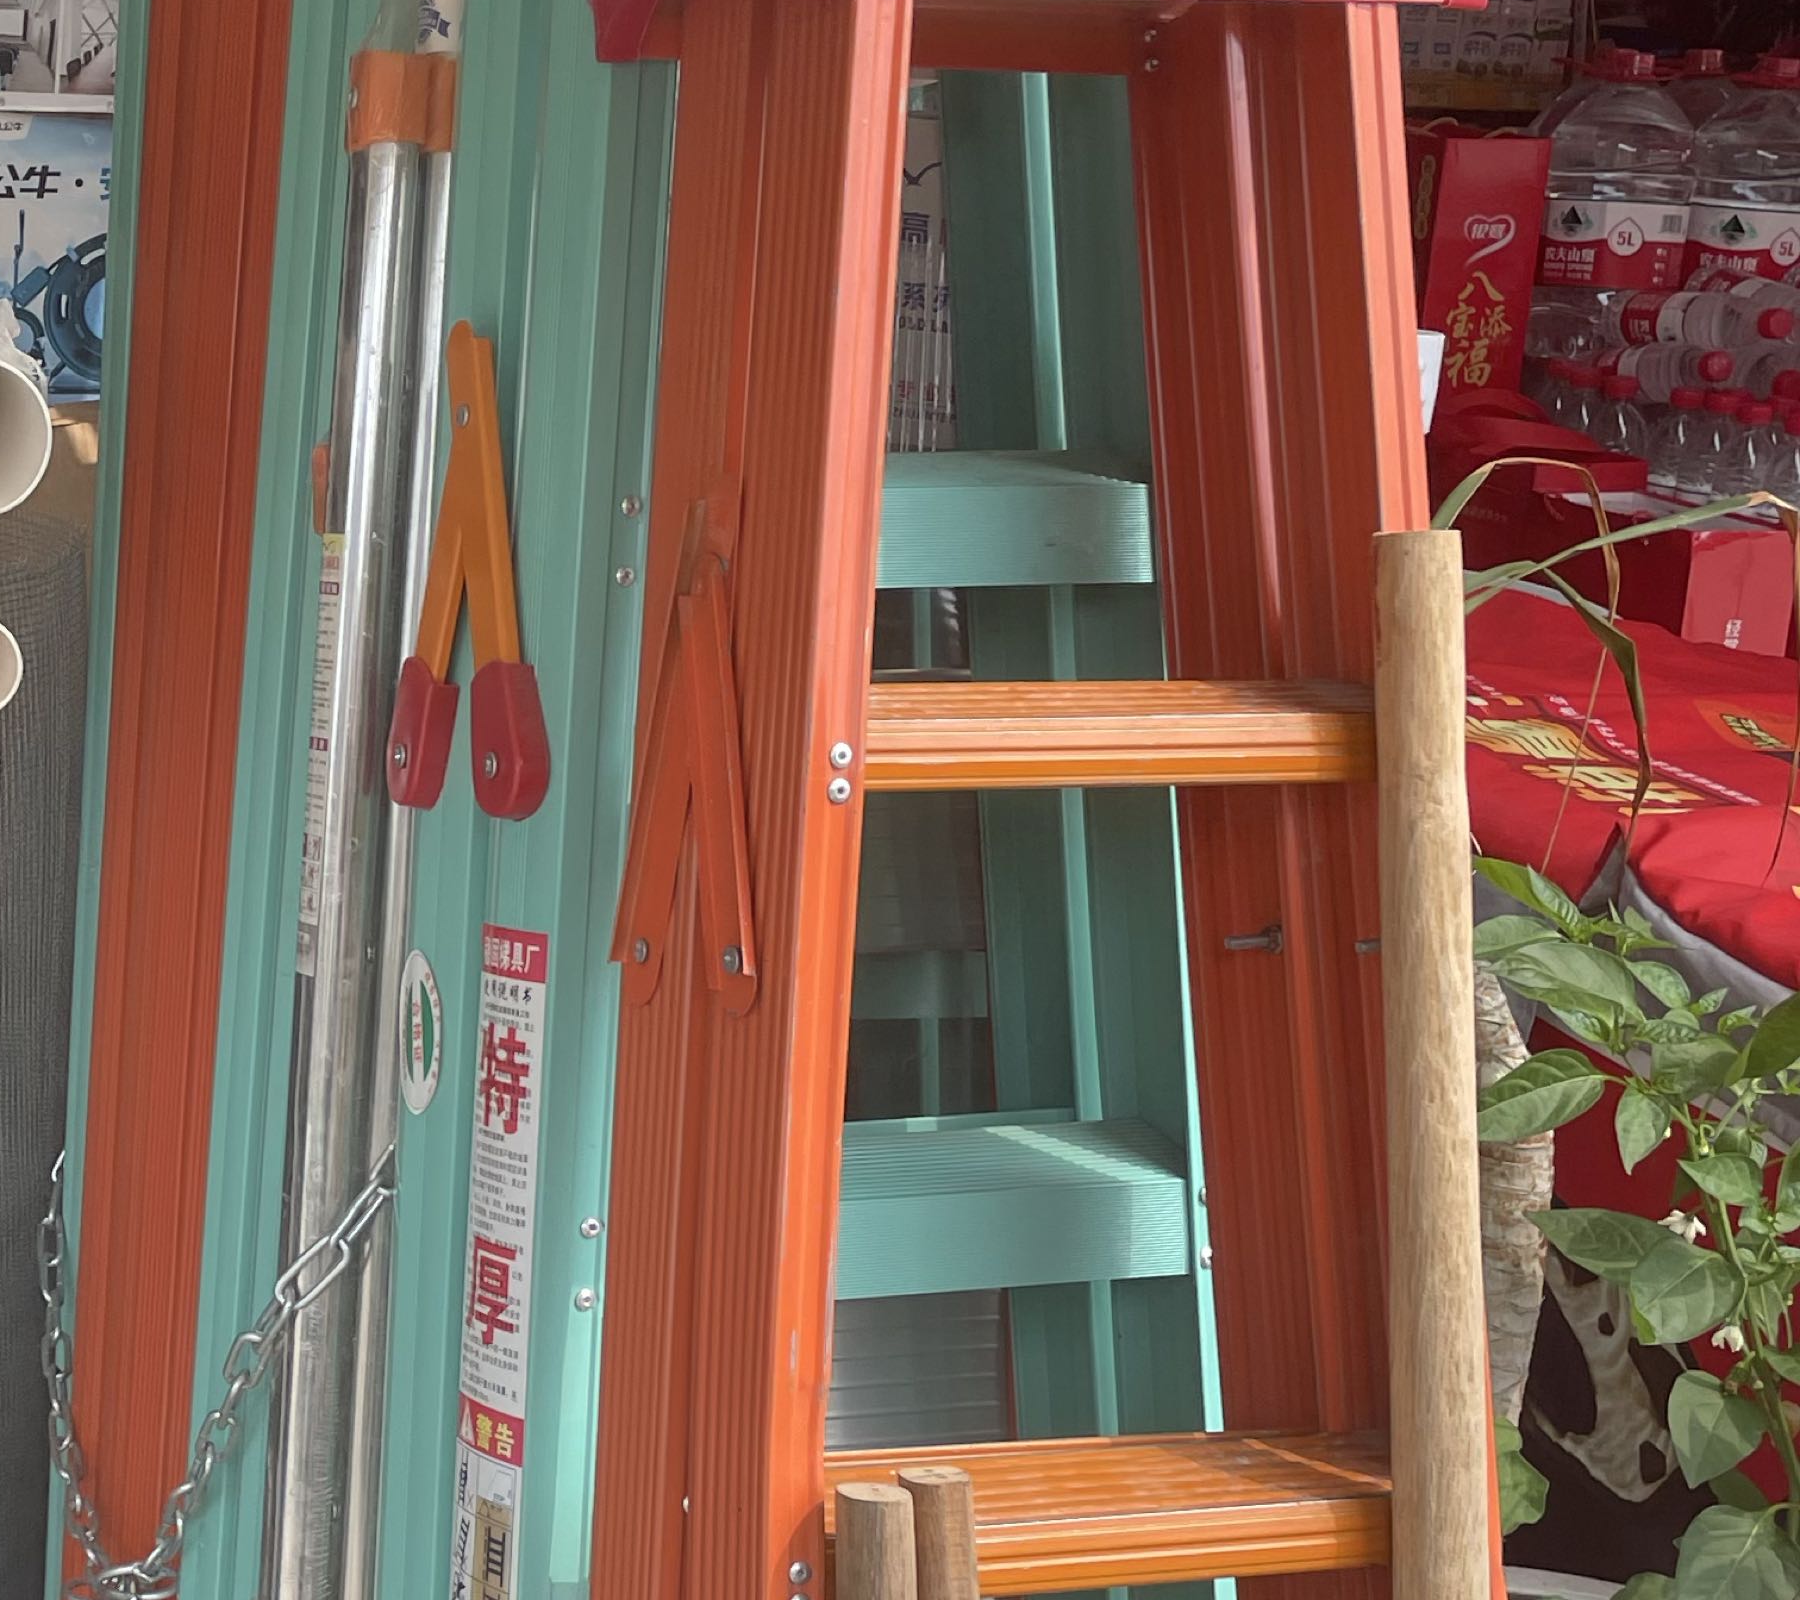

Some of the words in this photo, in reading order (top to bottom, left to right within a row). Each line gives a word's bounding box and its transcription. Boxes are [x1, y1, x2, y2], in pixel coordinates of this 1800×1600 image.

[1617, 231, 1635, 247] 5L
[1778, 241, 1795, 257] 5L
[475, 1413, 515, 1459] 警告
